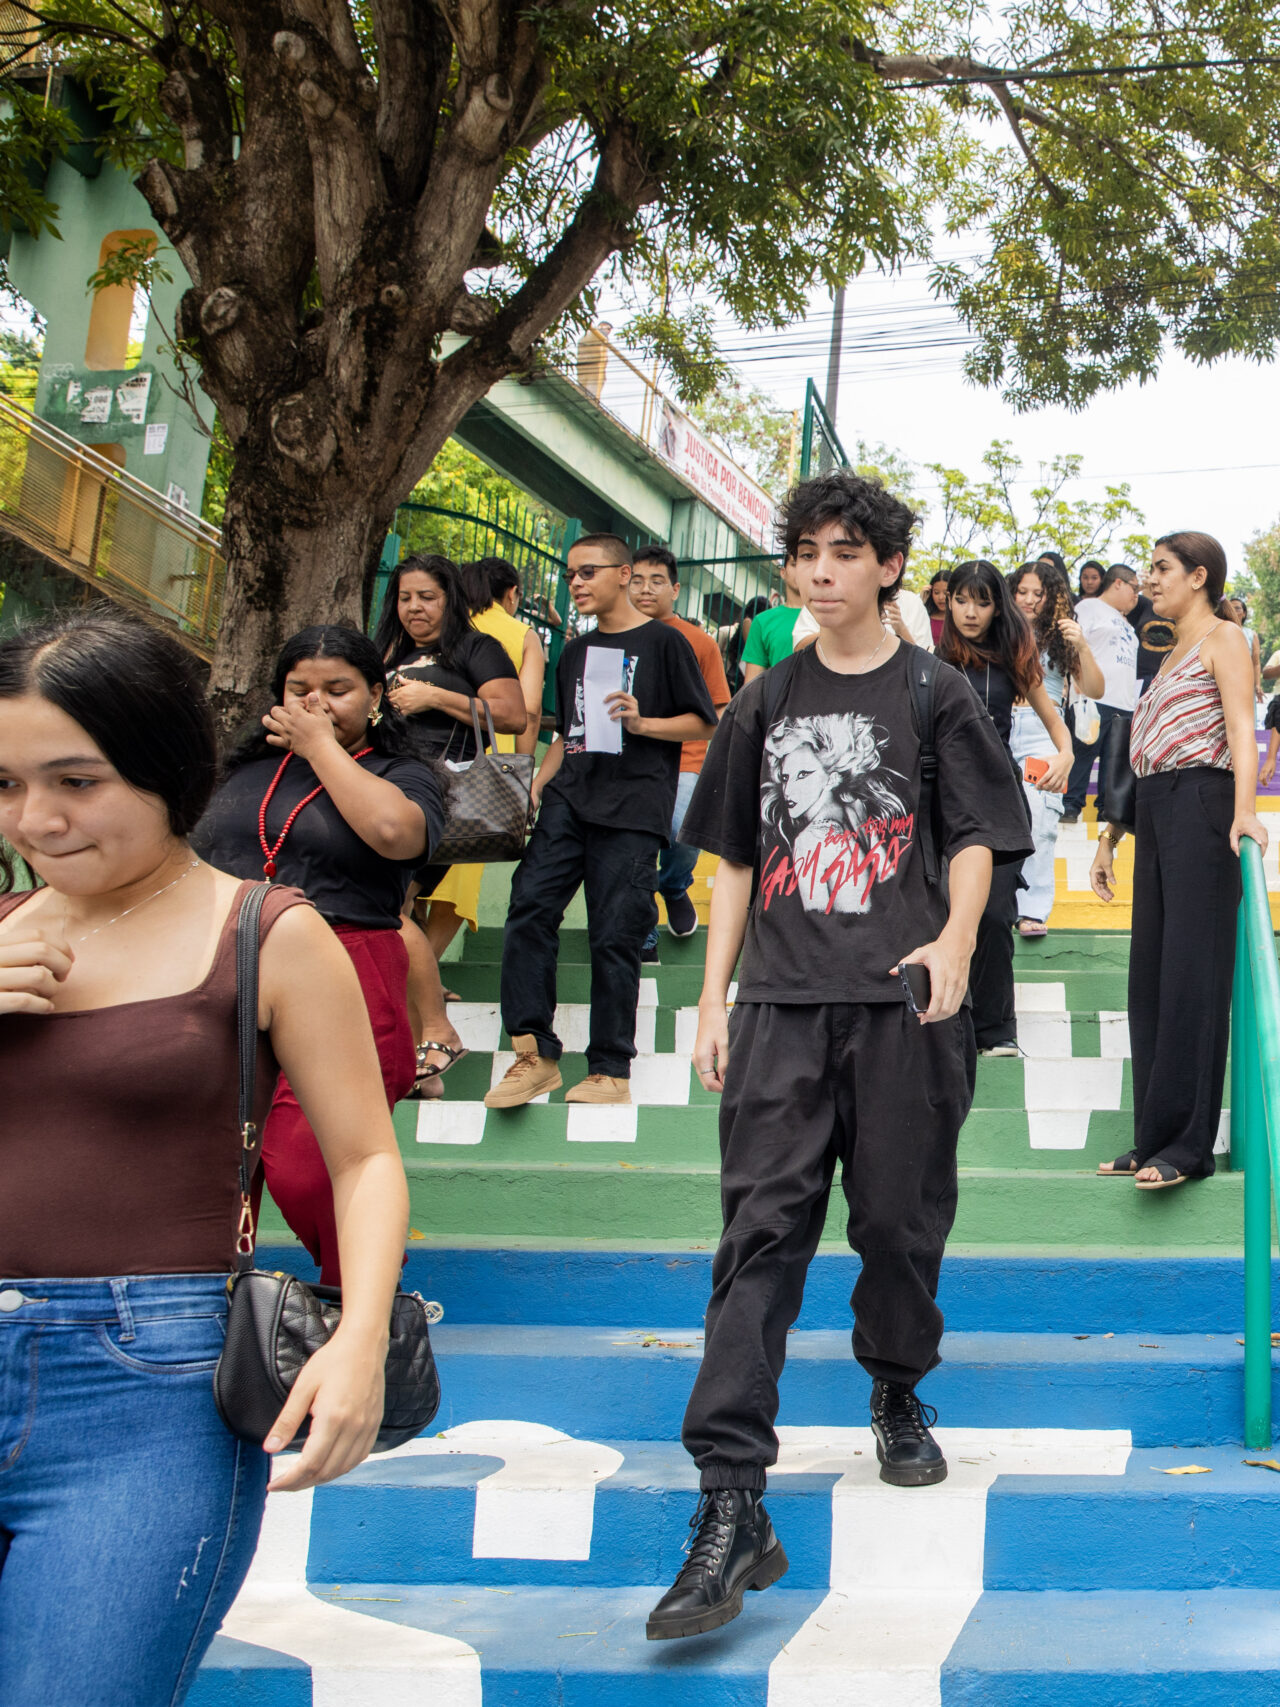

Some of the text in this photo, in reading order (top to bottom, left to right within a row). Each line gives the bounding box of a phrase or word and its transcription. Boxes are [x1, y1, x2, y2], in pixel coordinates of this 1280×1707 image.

[720, 465, 737, 498] POR
[761, 836, 912, 915] LADY GAGA
